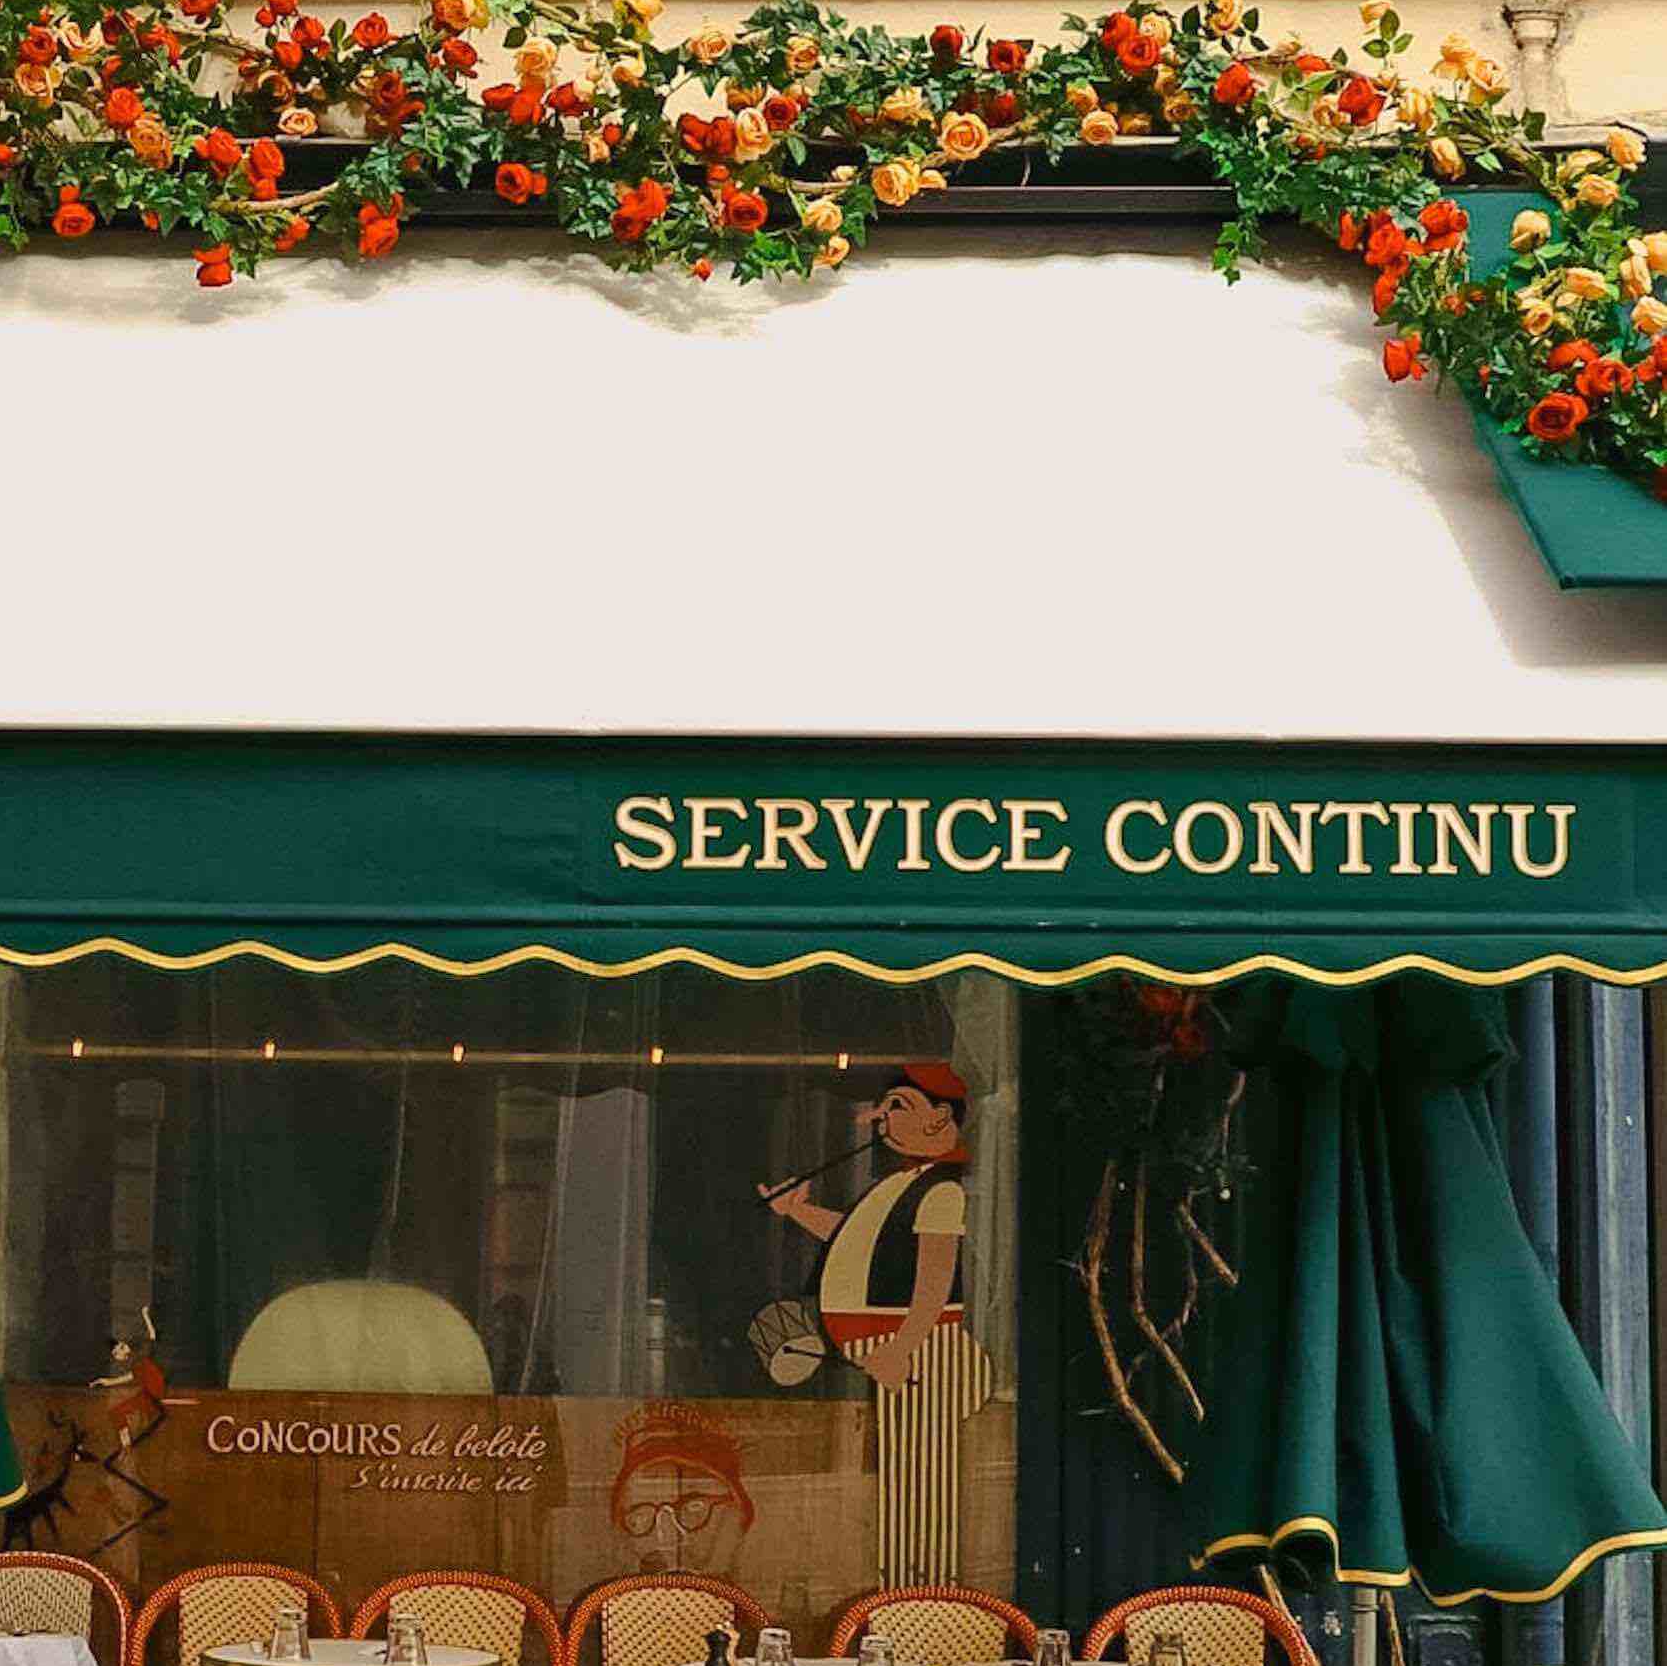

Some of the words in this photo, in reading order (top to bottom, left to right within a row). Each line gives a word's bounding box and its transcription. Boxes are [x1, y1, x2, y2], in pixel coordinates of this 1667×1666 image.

[613, 796, 1072, 872] SERVICE
[1105, 800, 1576, 878] CONTINU
[410, 1424, 448, 1457] de
[453, 1423, 547, 1459] belote
[495, 1465, 543, 1492] ici
